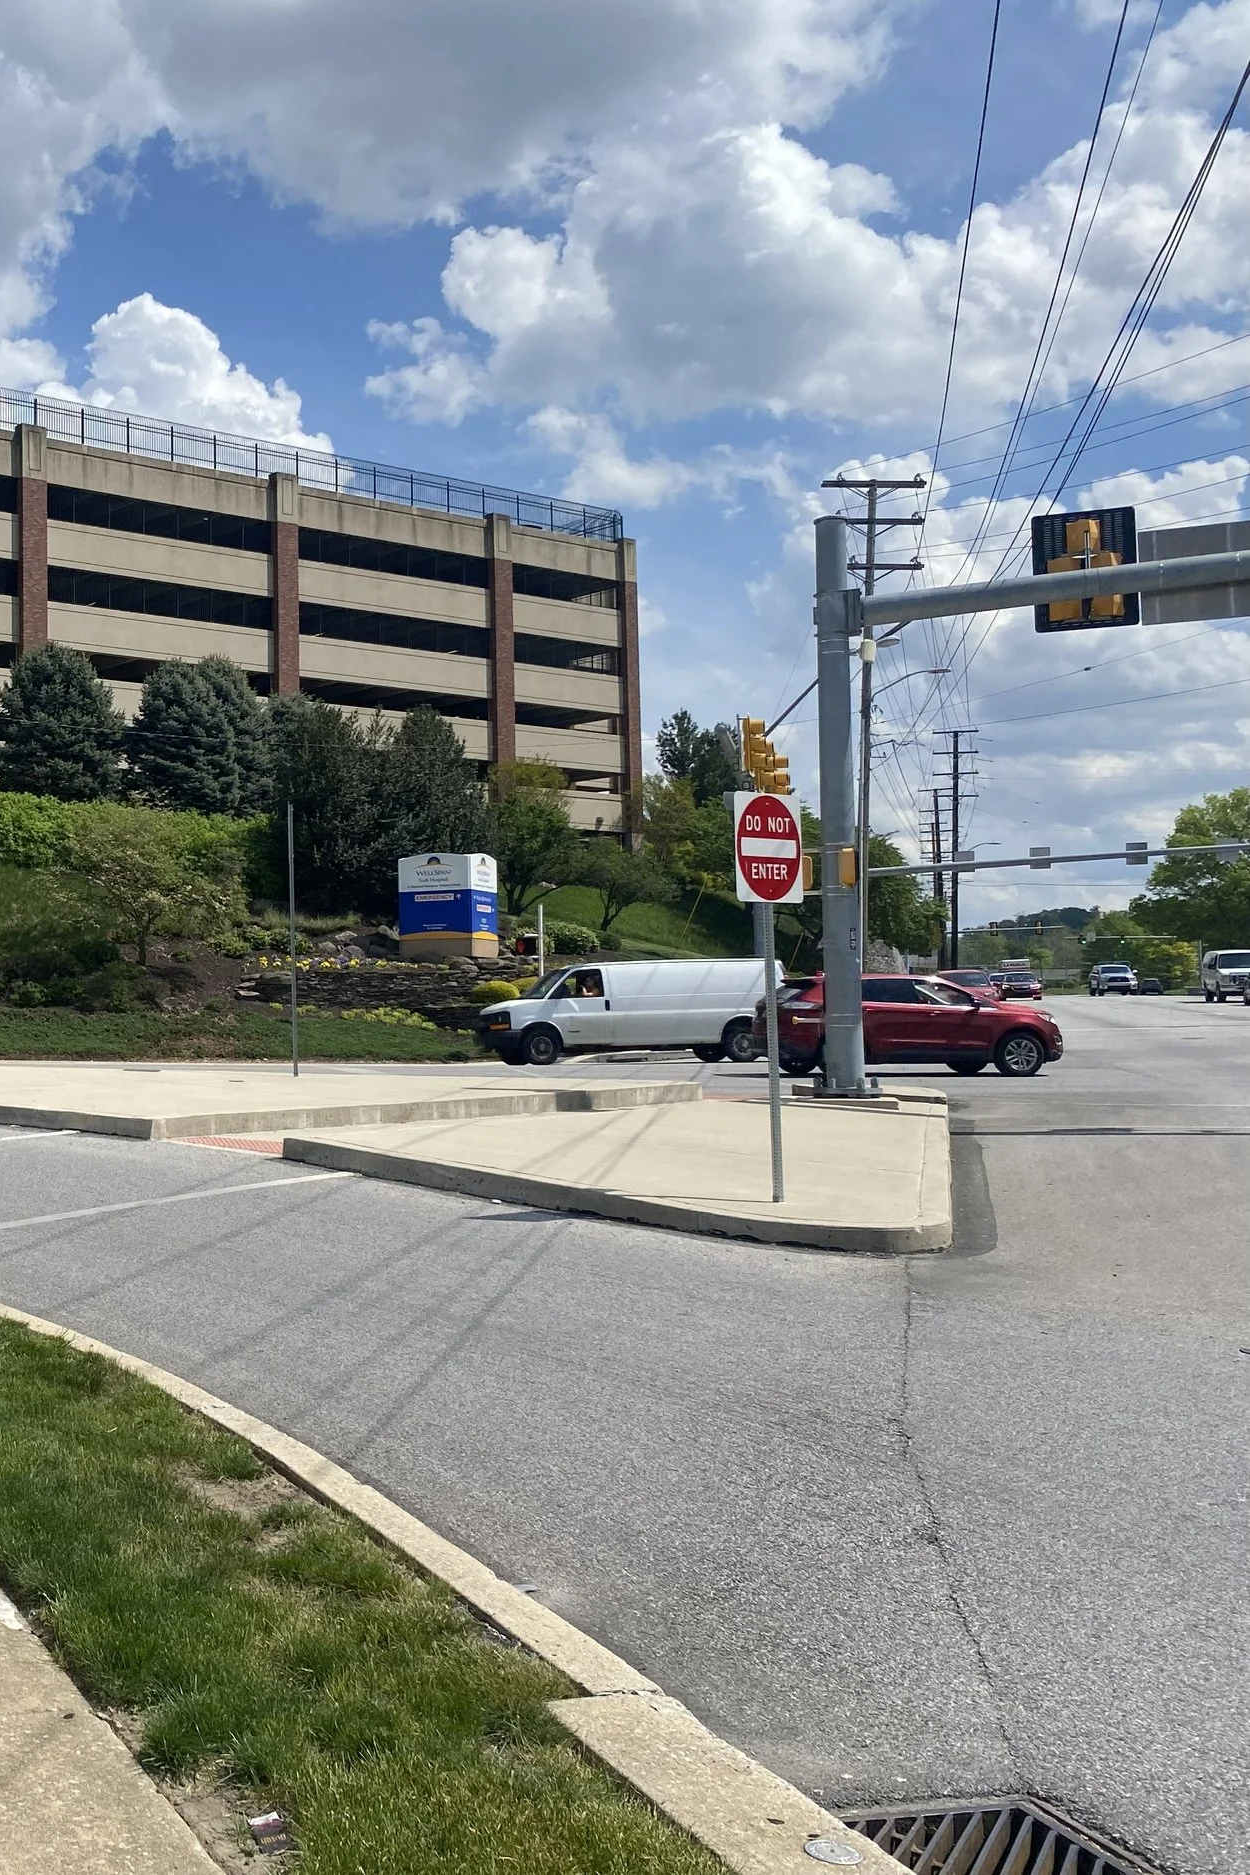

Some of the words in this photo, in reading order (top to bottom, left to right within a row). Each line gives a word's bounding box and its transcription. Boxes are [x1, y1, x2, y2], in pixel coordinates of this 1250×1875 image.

[745, 815, 761, 831] DO
[768, 816, 791, 834] NOT
[751, 863, 788, 880] ENTER
